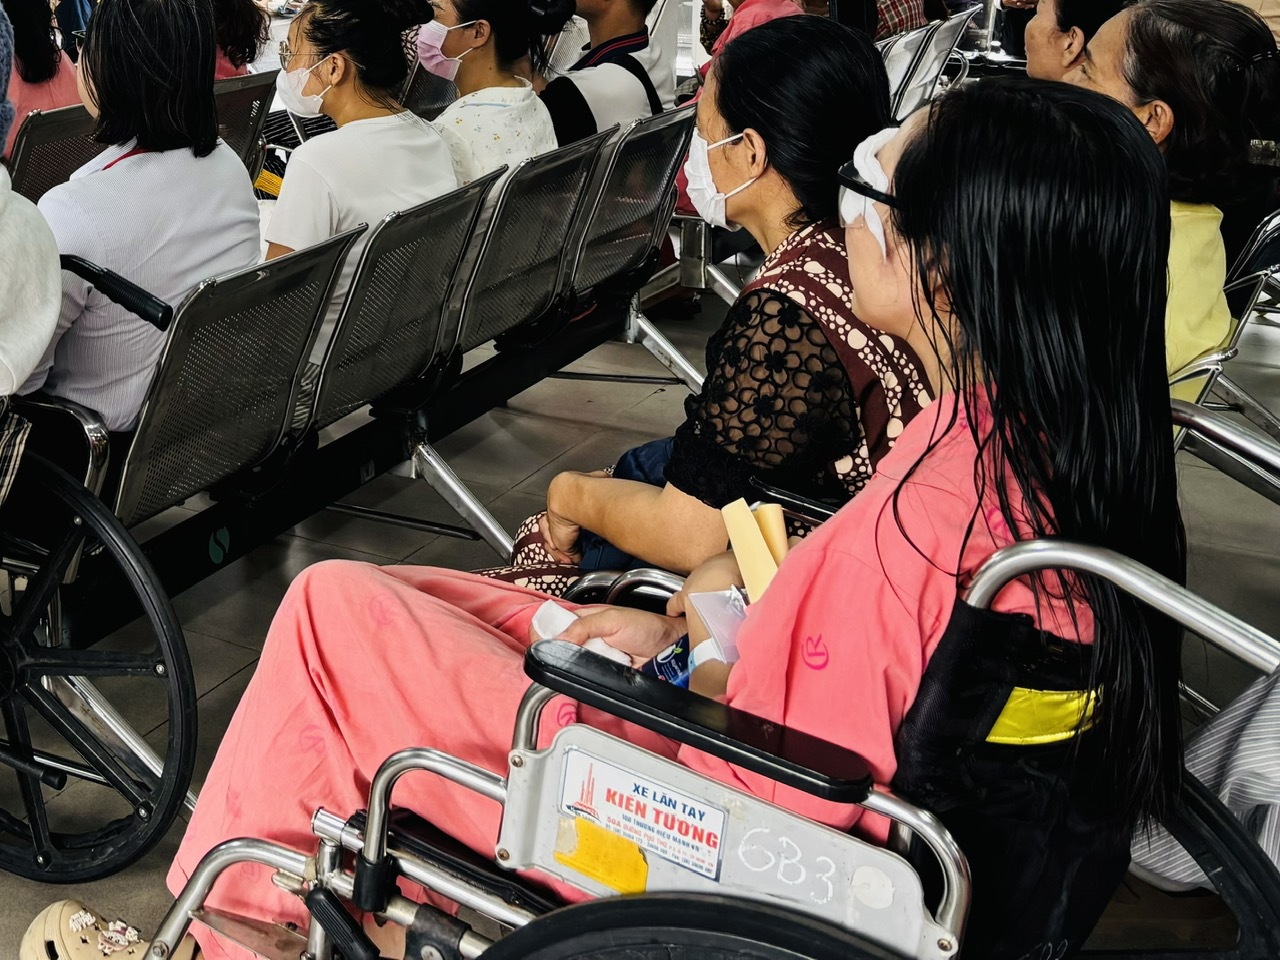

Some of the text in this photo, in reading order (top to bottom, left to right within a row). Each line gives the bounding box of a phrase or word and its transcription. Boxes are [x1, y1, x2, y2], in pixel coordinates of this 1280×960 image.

[632, 782, 706, 823] XE LĂN TAY
[737, 826, 836, 904] 6B3
